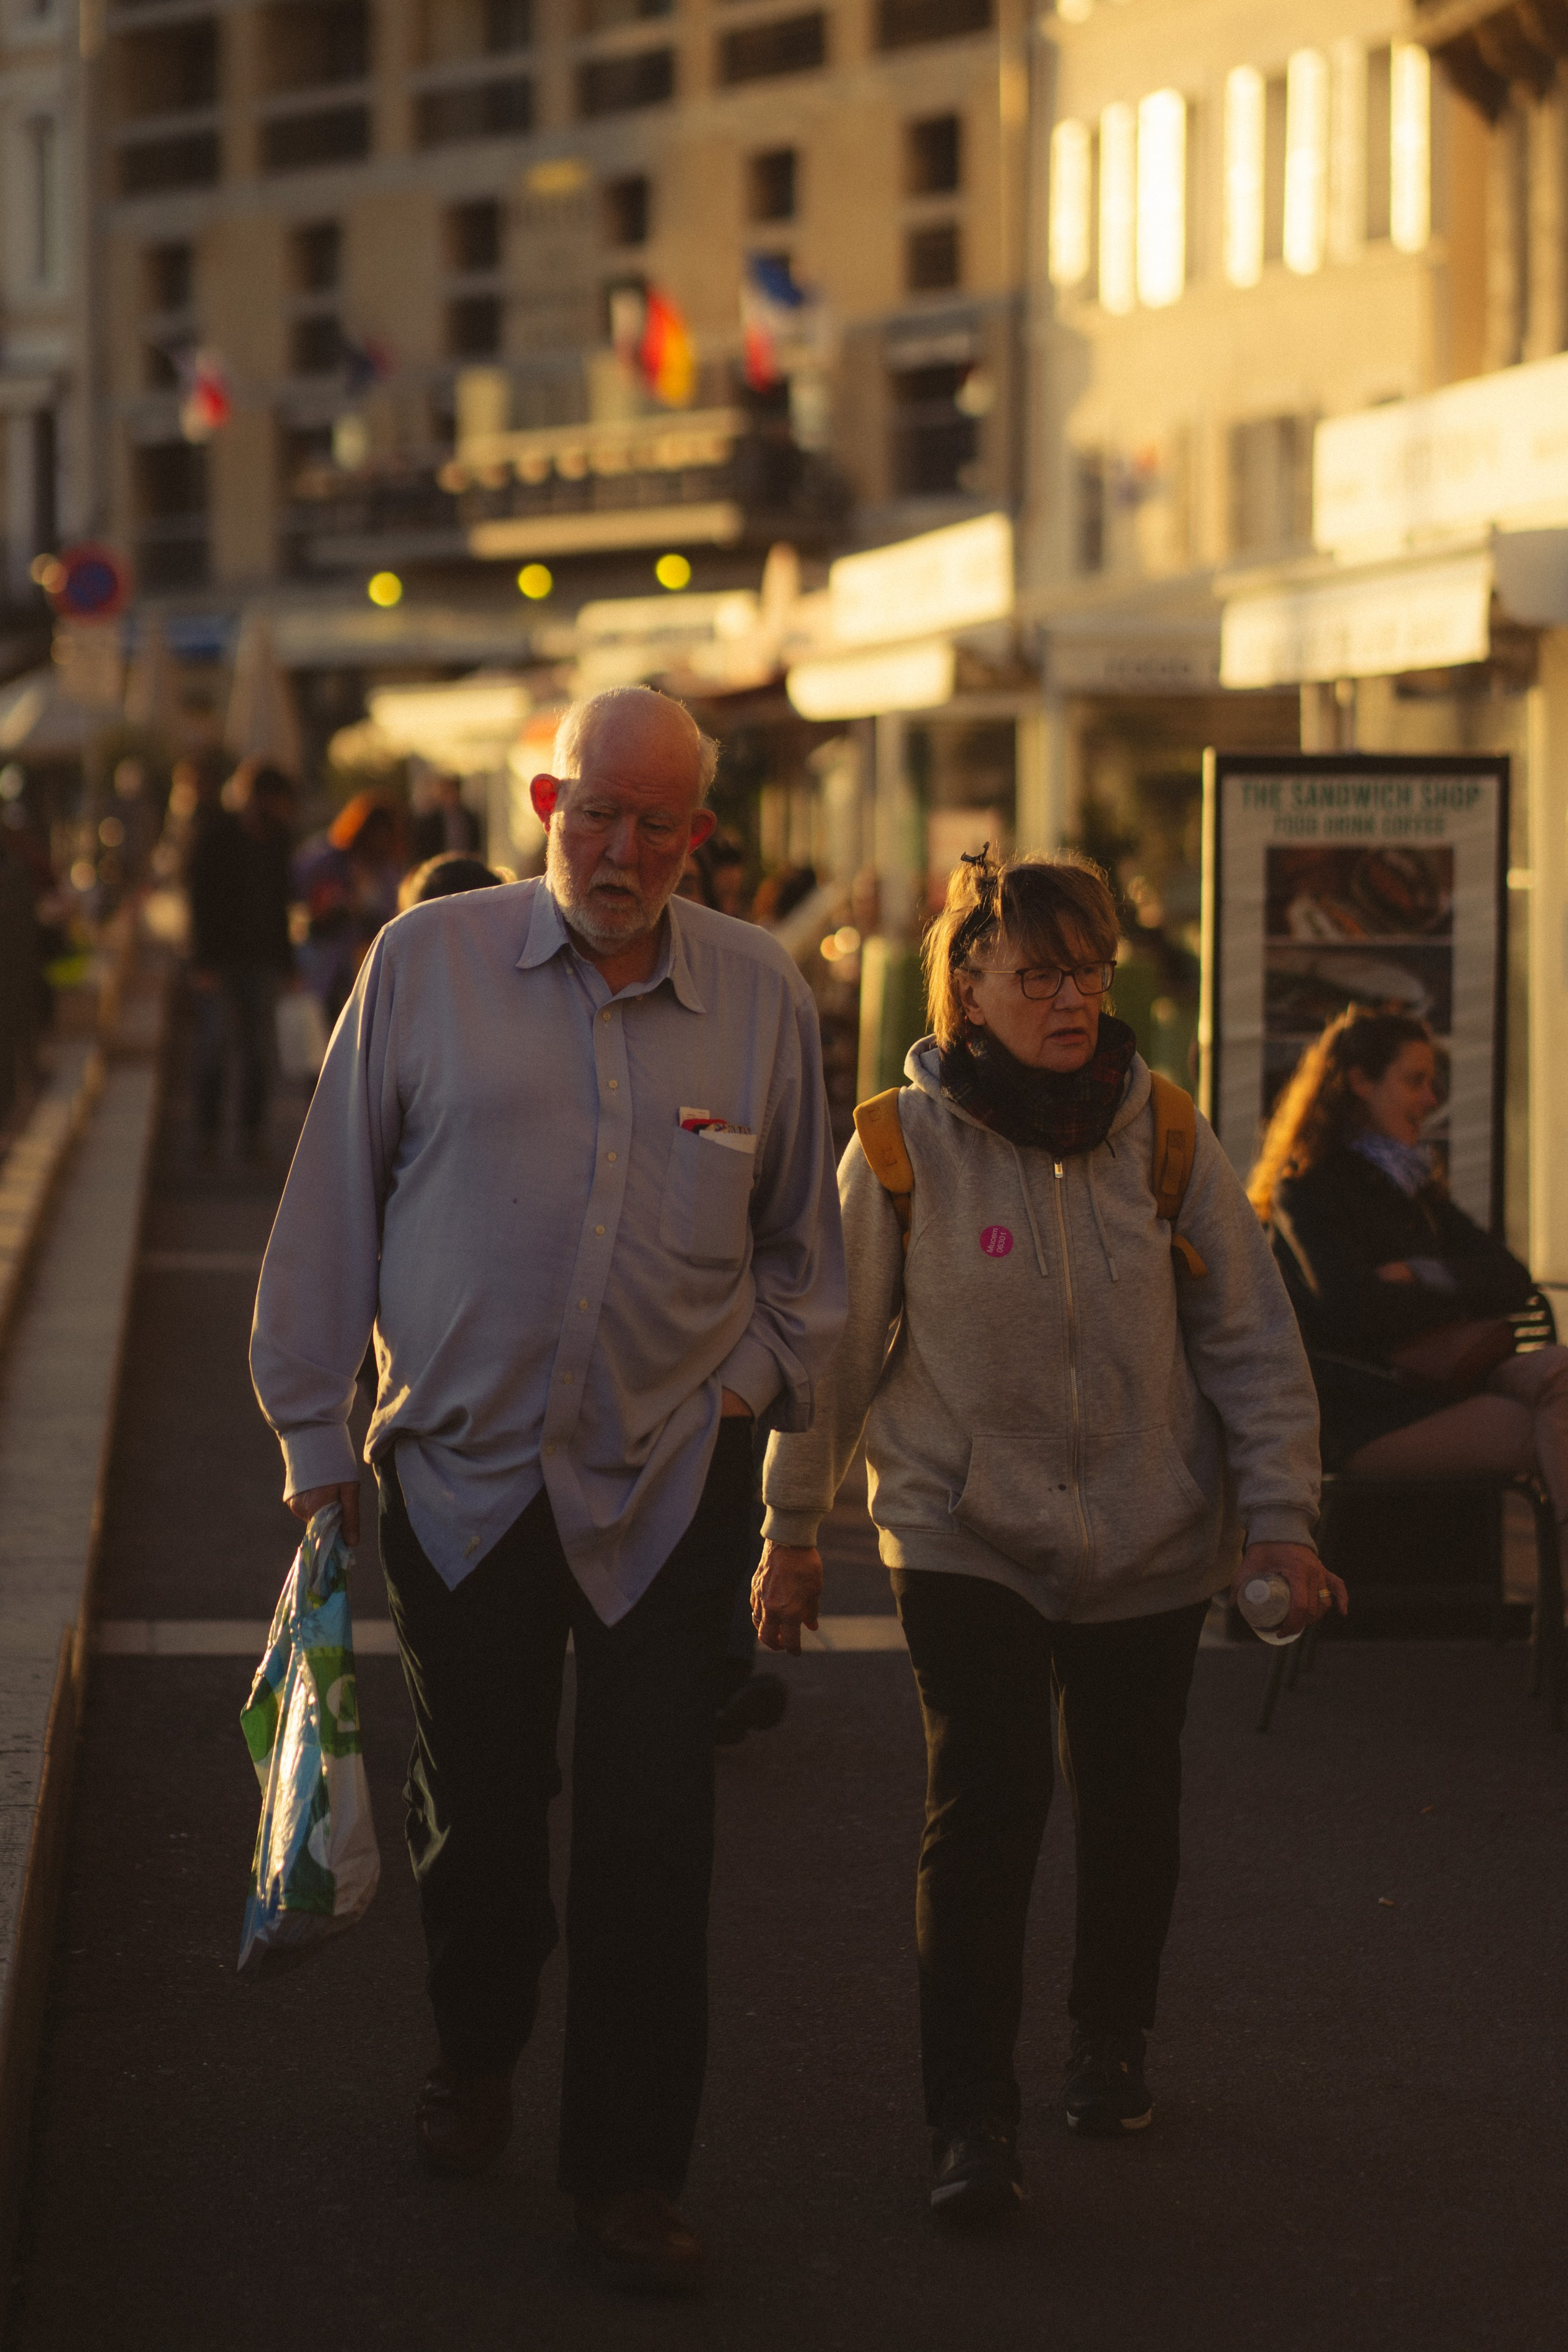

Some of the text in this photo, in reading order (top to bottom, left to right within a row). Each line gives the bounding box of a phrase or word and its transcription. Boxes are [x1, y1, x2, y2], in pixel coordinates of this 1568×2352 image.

[1242, 782, 1480, 809] THE SANDWICH SHOP
[1324, 816, 1374, 835] DRINK
[1381, 816, 1444, 836] COFFEE
[987, 1228, 998, 1253] Mucem
[997, 1232, 1006, 1253] 06301
